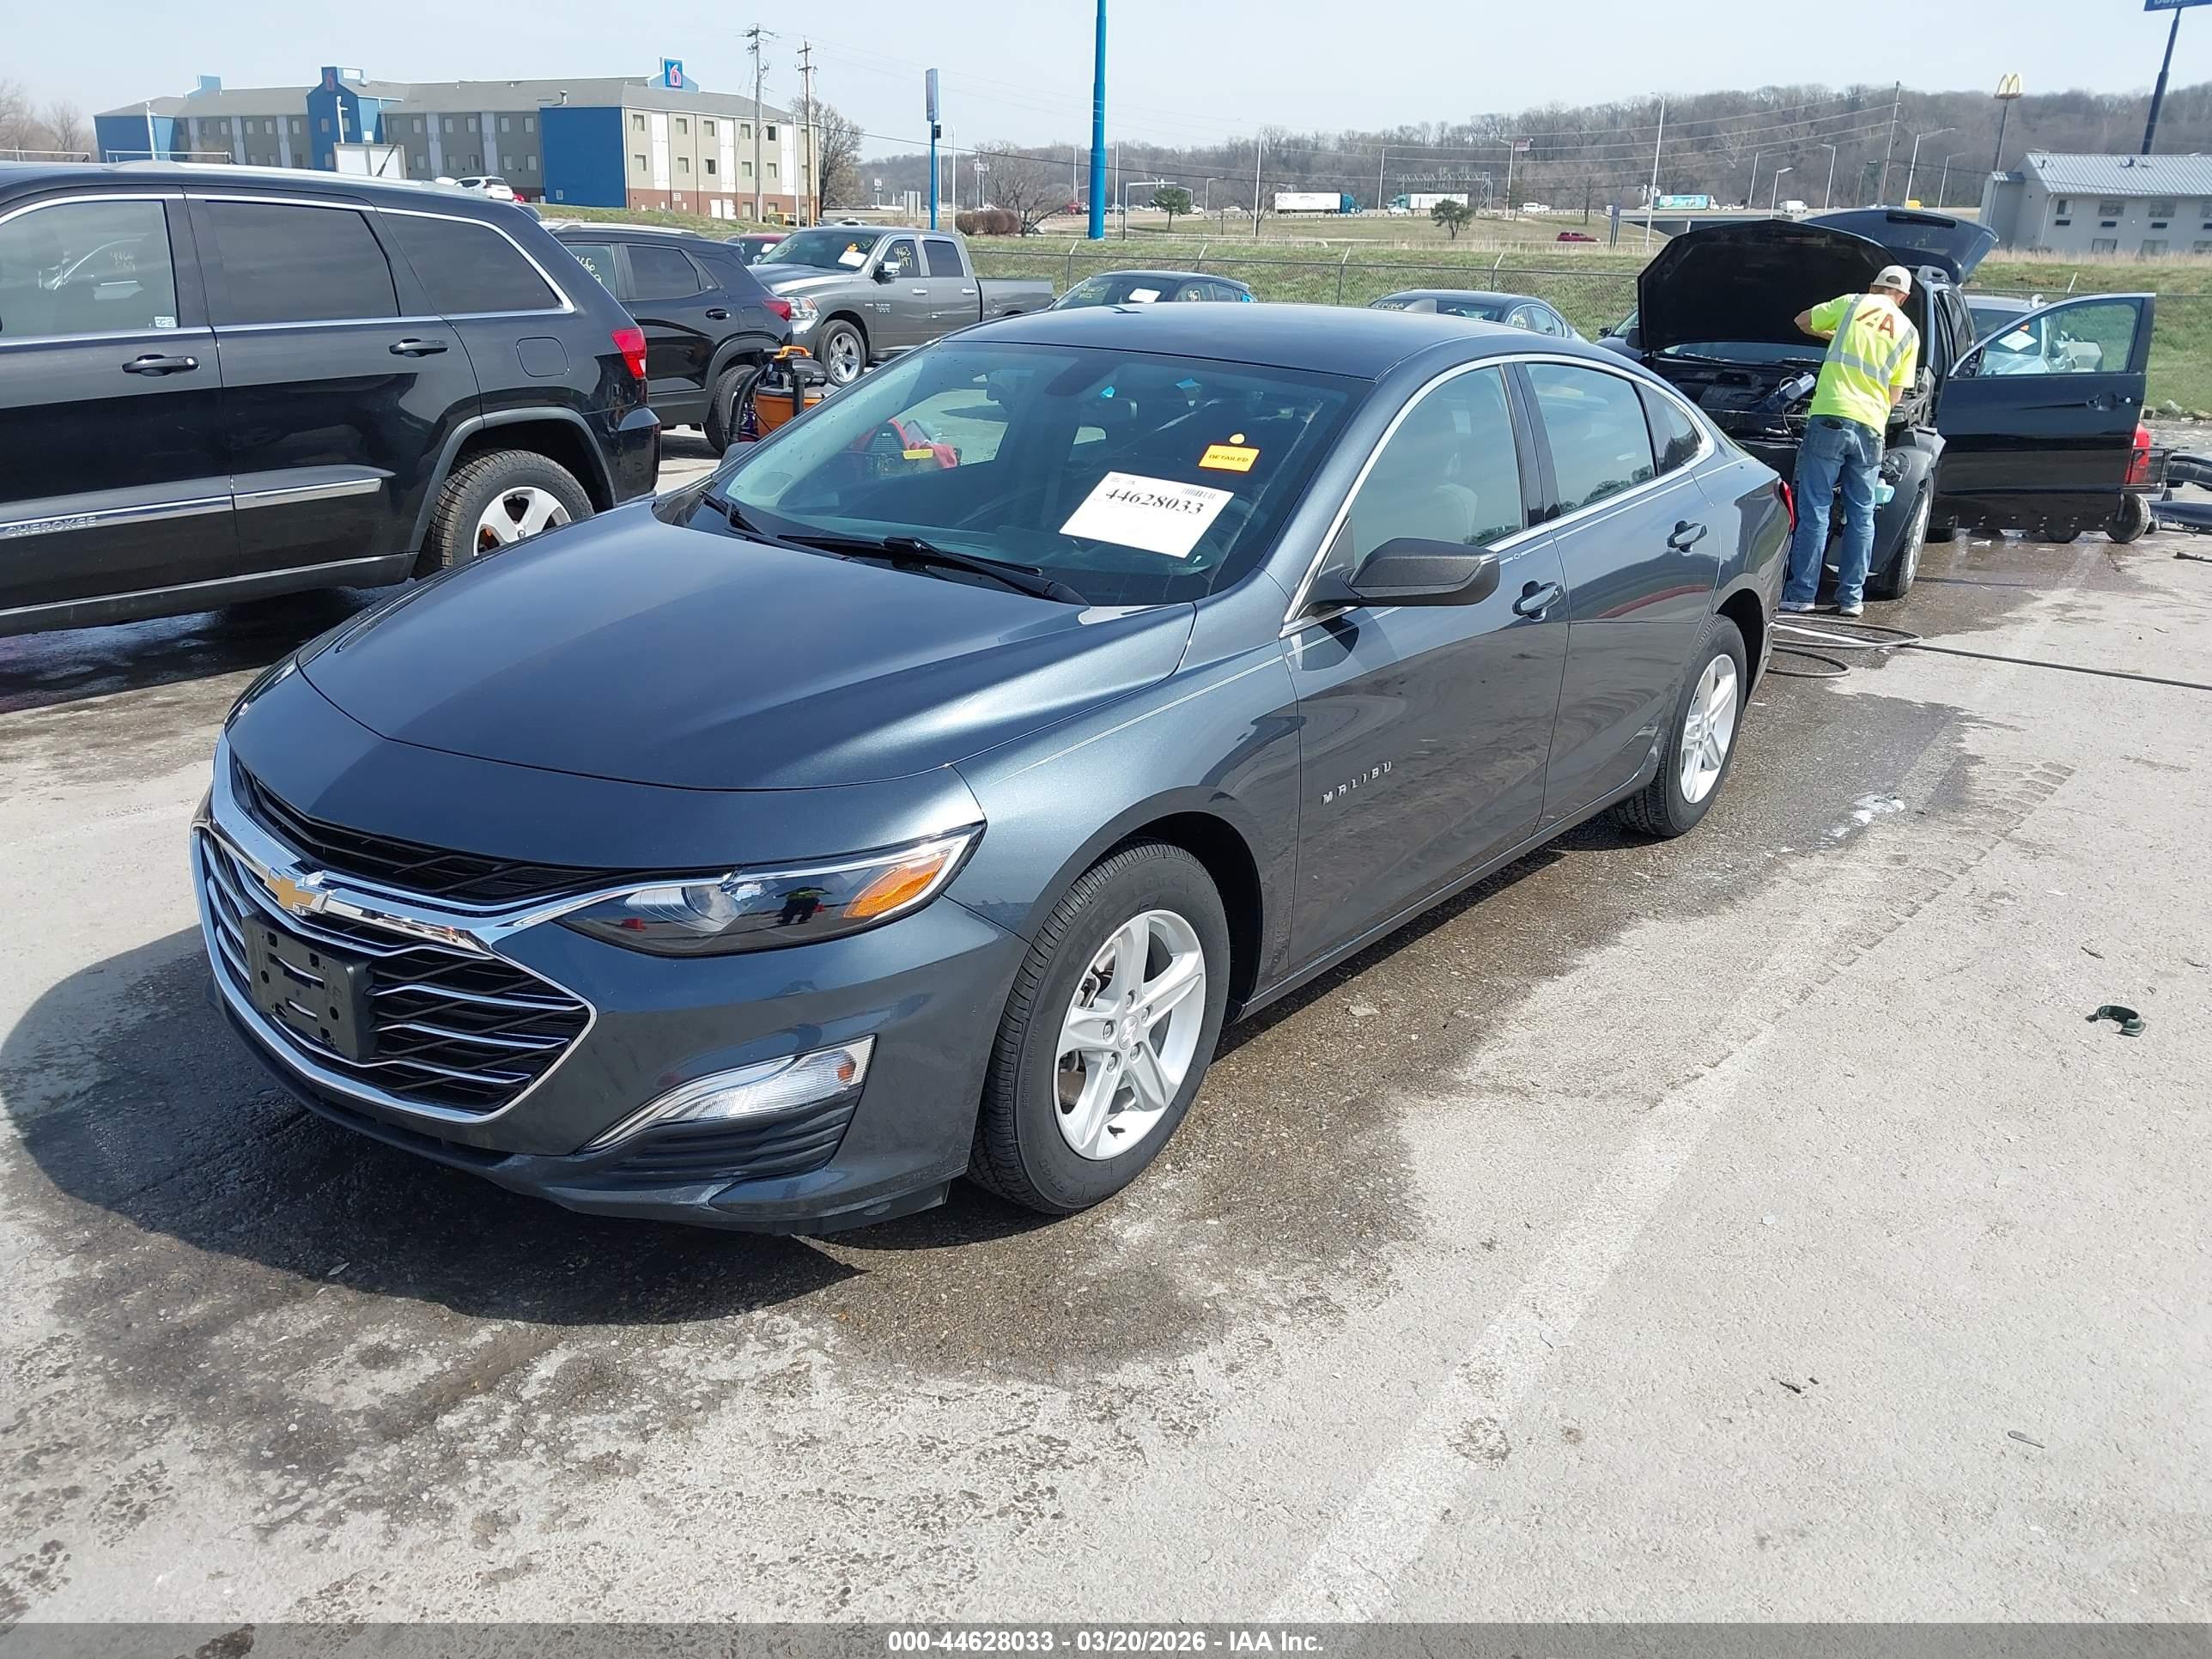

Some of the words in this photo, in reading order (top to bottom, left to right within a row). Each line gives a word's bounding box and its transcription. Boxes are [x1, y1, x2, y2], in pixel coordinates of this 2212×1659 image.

[670, 64, 682, 87] 6
[1208, 454, 1249, 463] DETAILED
[1105, 489, 1204, 515] 44628033
[5, 516, 97, 537] CHEROKEE
[1322, 761, 1392, 805] MALIBU
